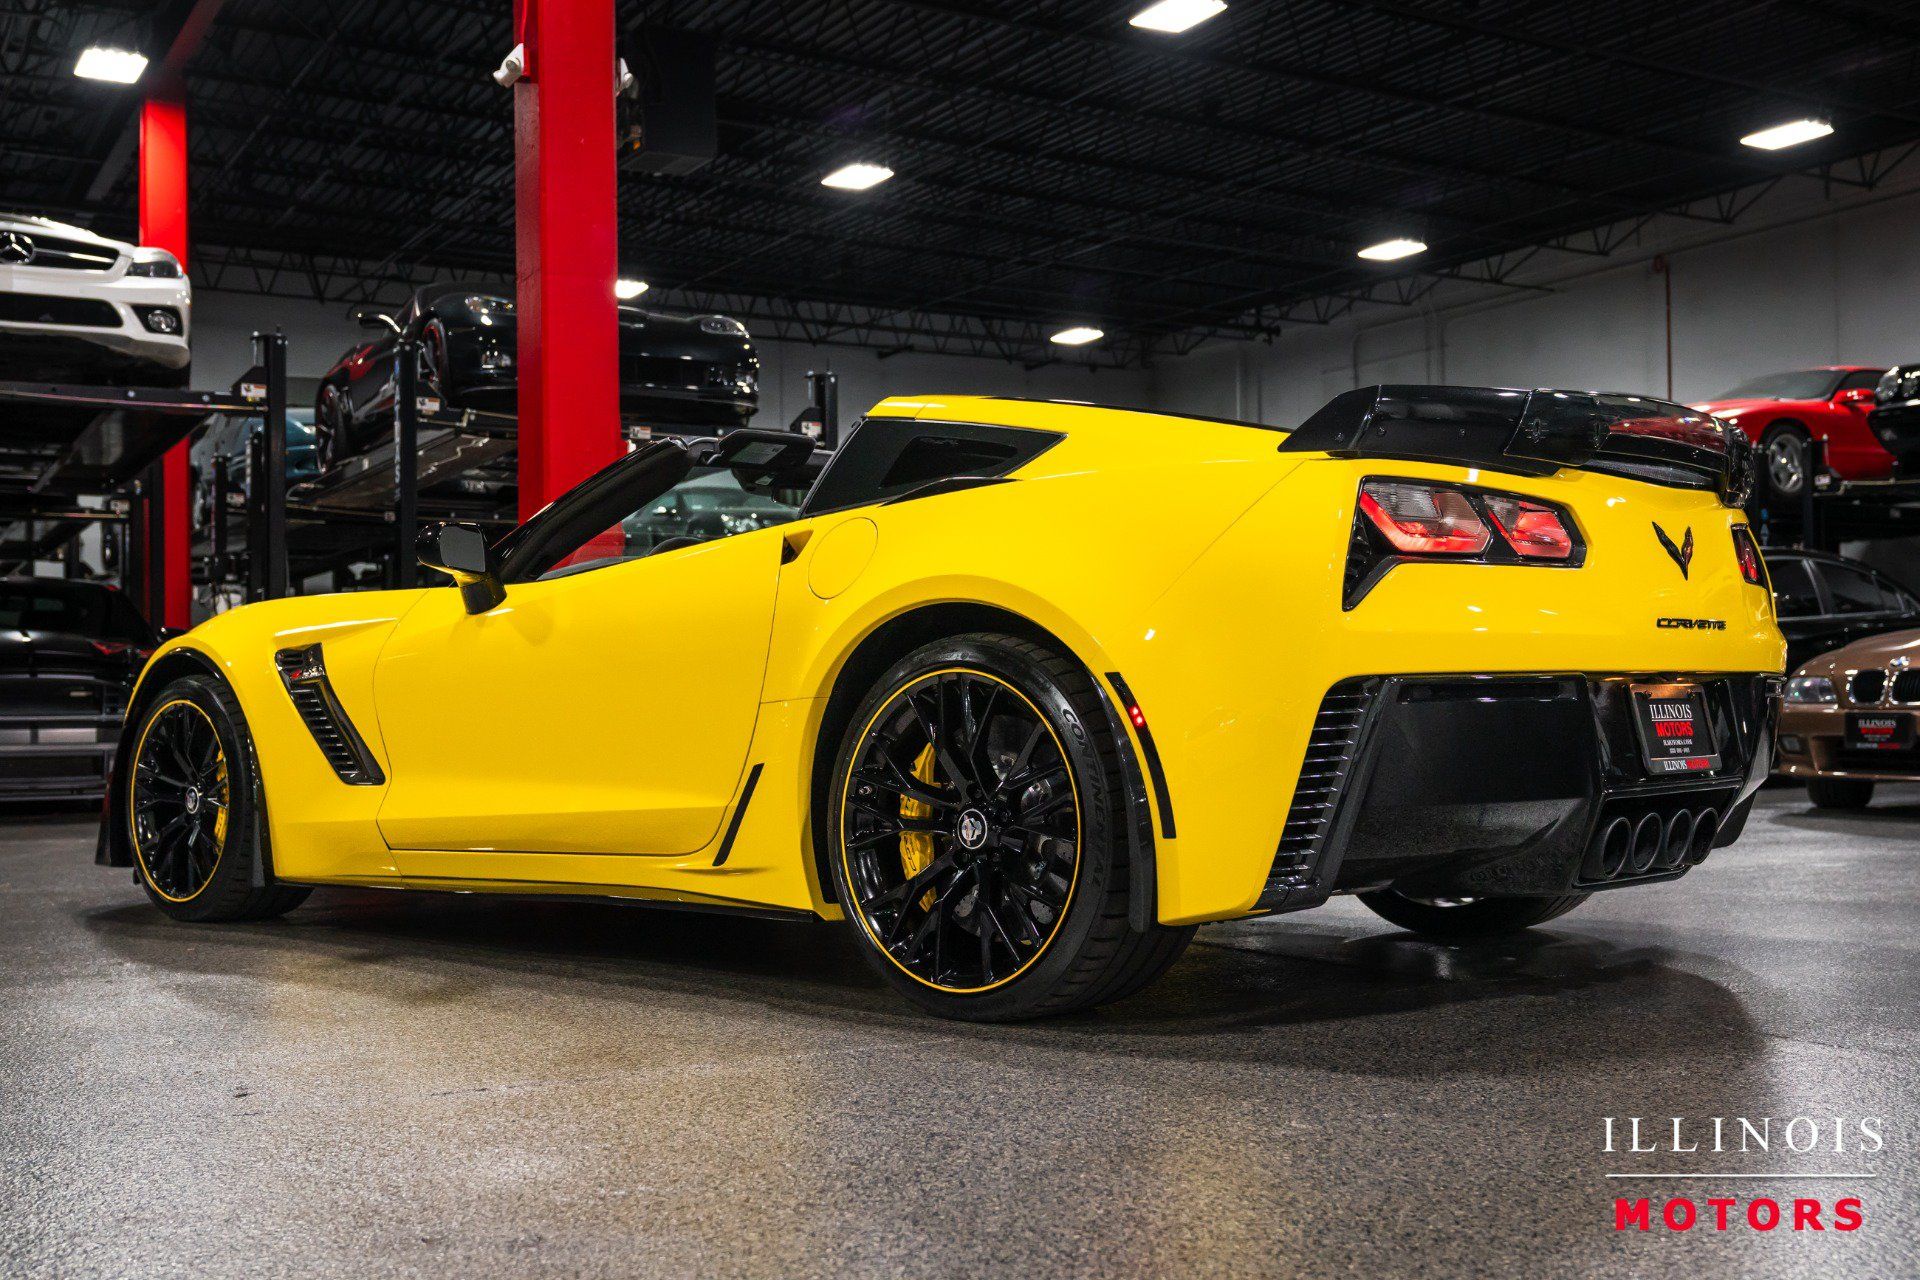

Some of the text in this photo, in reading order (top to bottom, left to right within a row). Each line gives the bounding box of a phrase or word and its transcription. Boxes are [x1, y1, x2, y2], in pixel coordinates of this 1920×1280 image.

[1656, 618, 1726, 630] CORVETTE
[1650, 704, 1693, 719] ILLINOIS
[1655, 721, 1694, 737] MOTORS
[1664, 760, 1688, 771] ILLINOIS
